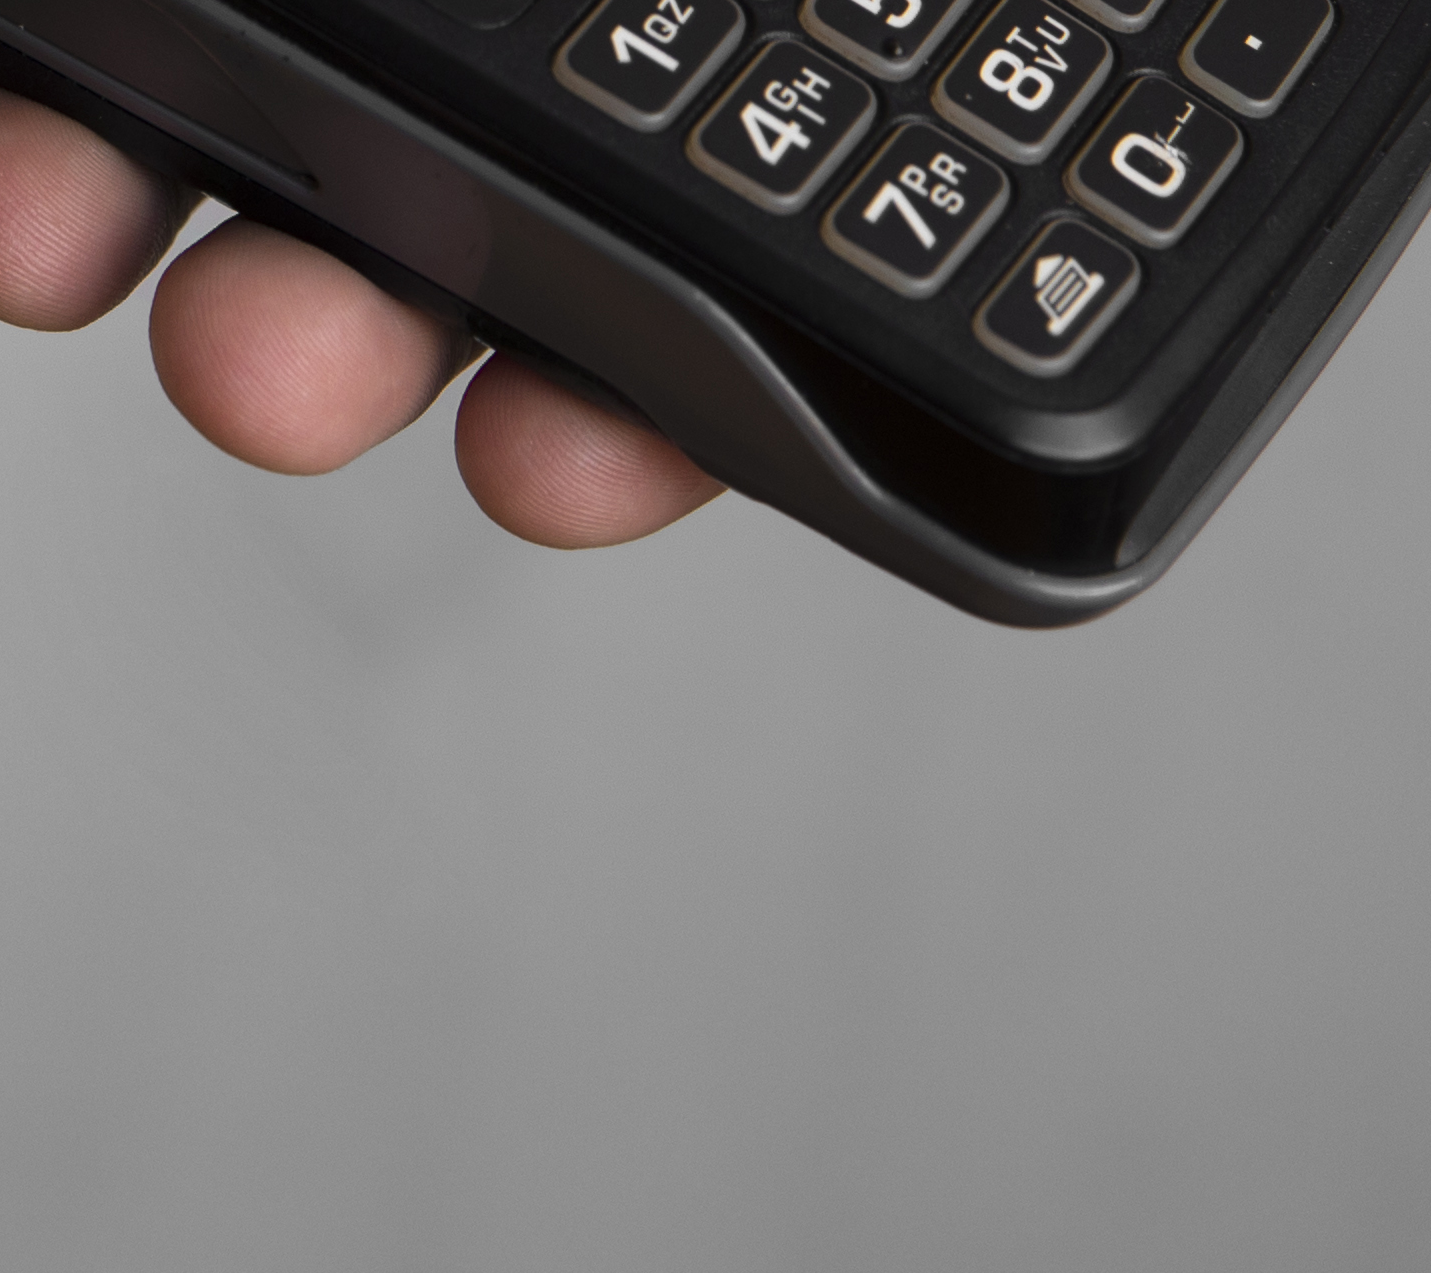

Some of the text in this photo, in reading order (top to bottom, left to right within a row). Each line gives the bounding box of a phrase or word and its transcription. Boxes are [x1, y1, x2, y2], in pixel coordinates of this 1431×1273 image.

[611, 25, 680, 72] 1
[980, 49, 1055, 112] 8
[741, 102, 811, 165] 4
[1111, 132, 1187, 198] 0
[864, 182, 936, 249] 7
